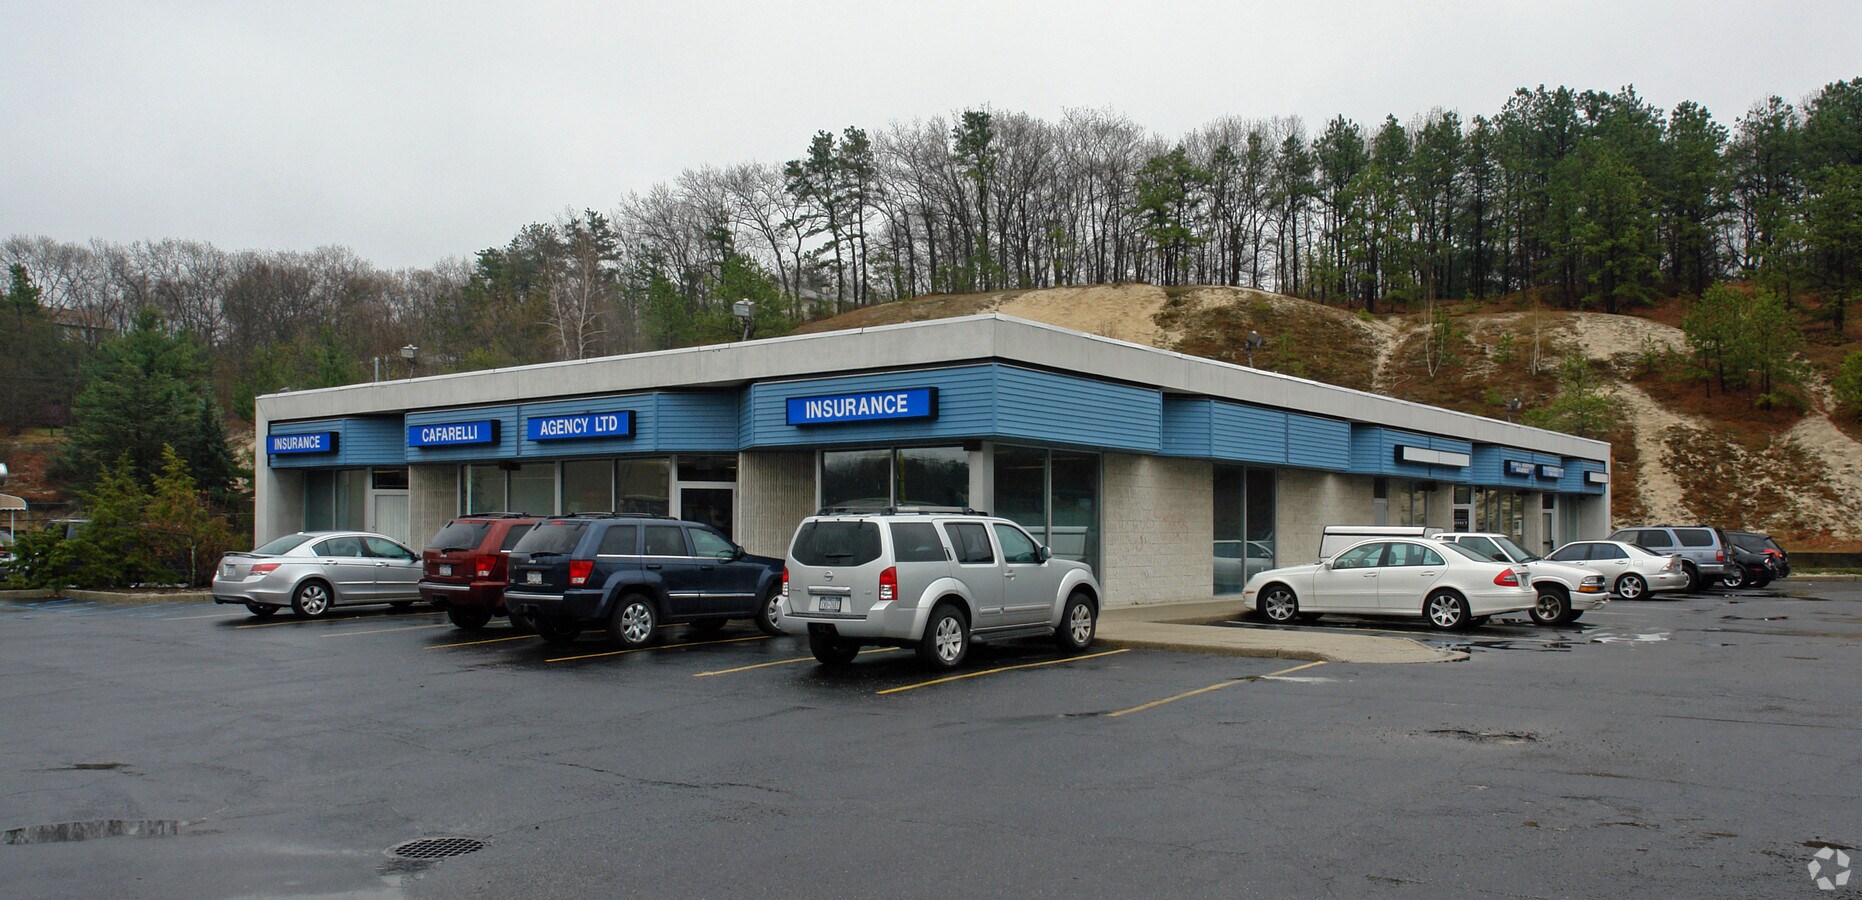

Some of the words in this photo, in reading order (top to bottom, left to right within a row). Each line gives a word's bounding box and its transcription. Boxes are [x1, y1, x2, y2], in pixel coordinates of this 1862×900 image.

[806, 394, 908, 418] INSURANCE
[422, 425, 478, 442] CAFARELLI
[540, 417, 589, 436] AGENCY
[595, 415, 618, 432] LTD
[274, 435, 321, 450] INSURANCE
